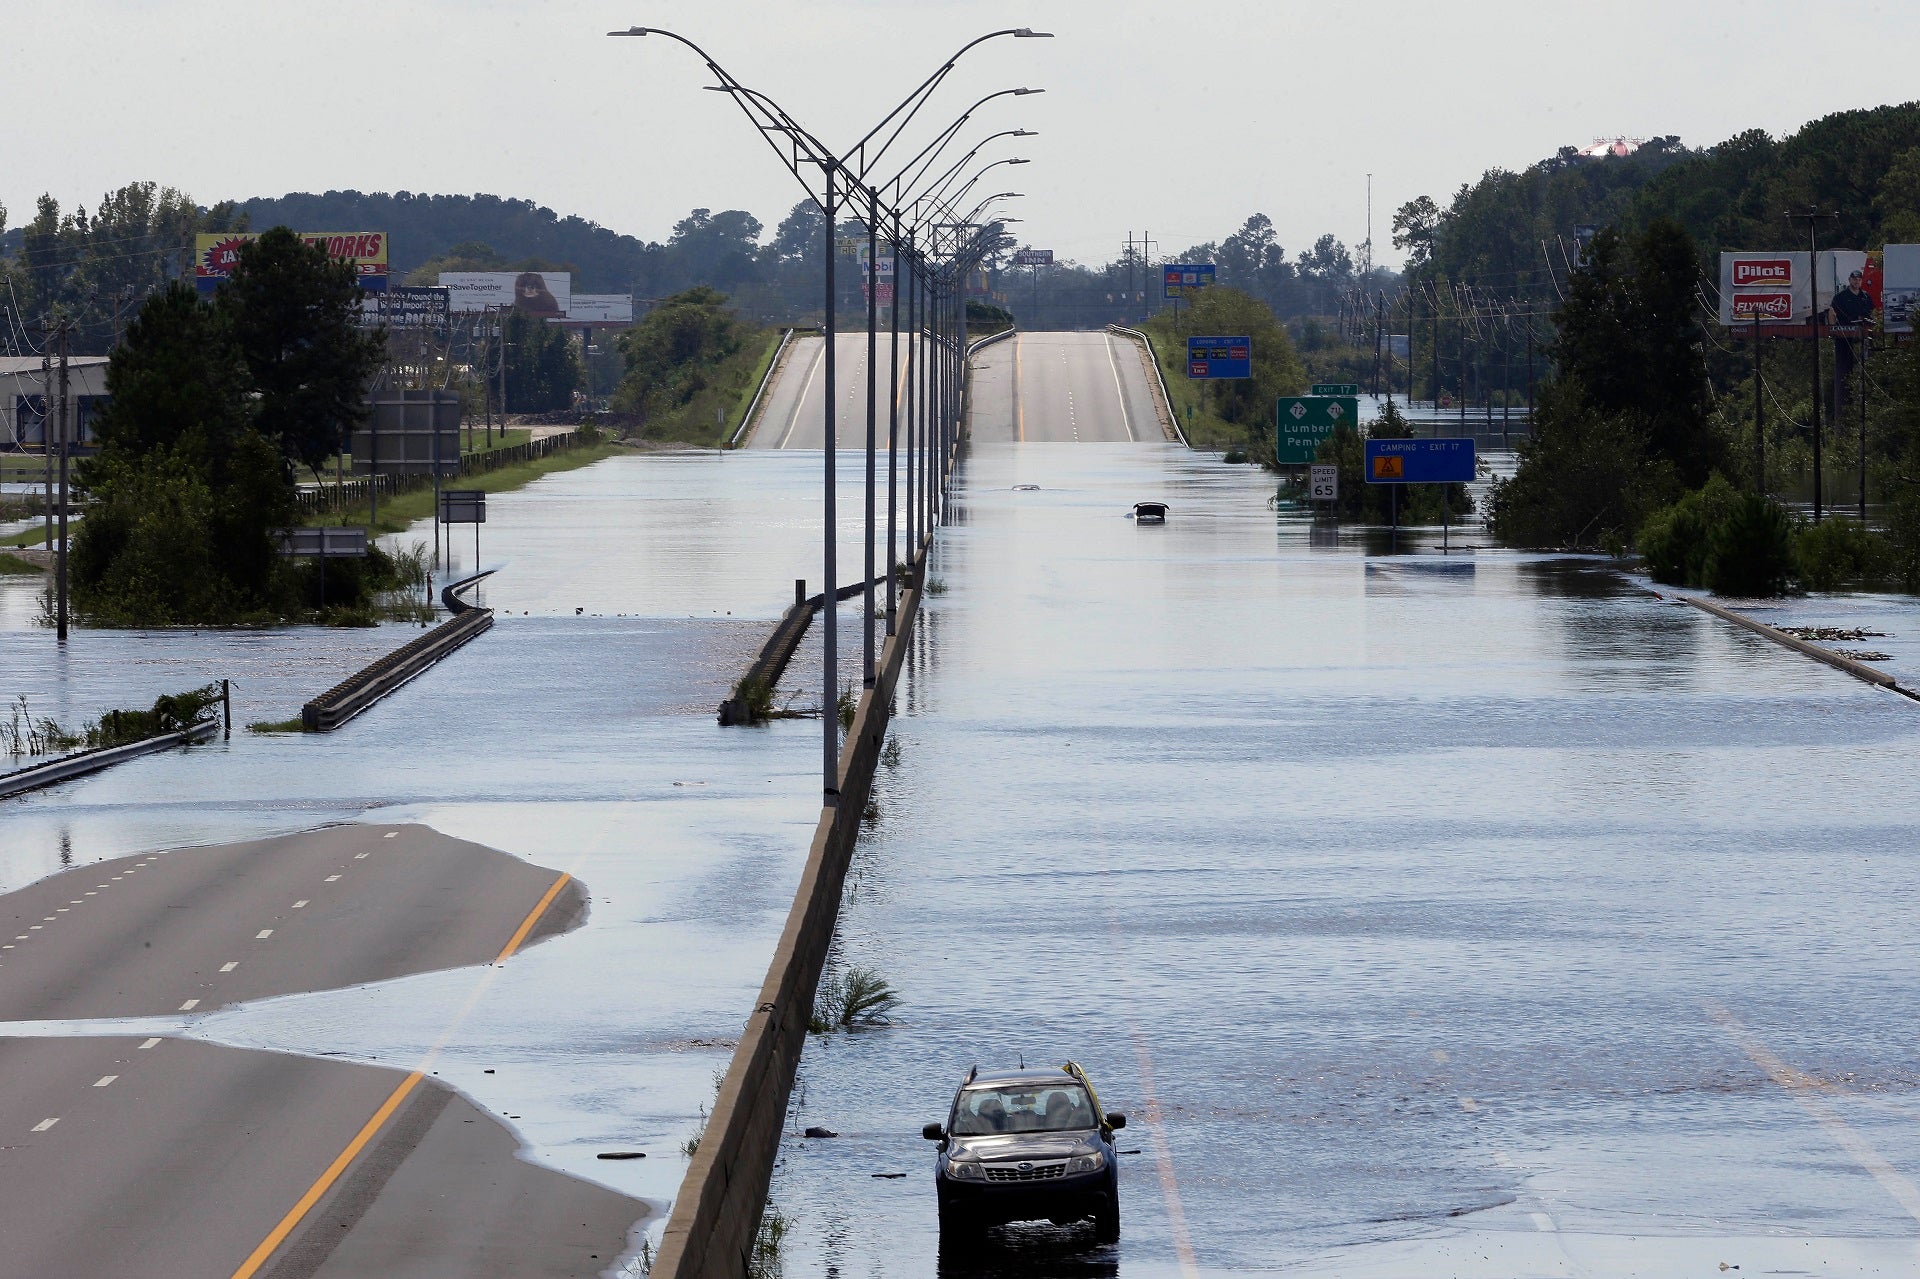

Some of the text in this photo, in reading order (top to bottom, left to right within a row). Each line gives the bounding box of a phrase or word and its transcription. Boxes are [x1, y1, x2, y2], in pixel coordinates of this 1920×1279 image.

[1738, 265, 1784, 279] Pilot
[1737, 302, 1774, 311] FLYING
[1341, 386, 1351, 394] 17
[1293, 406, 1304, 415] 72
[1284, 424, 1335, 433] Lumber
[1287, 437, 1322, 446] Pemb
[1380, 444, 1416, 452] CAMPING
[1315, 485, 1333, 496] 65
